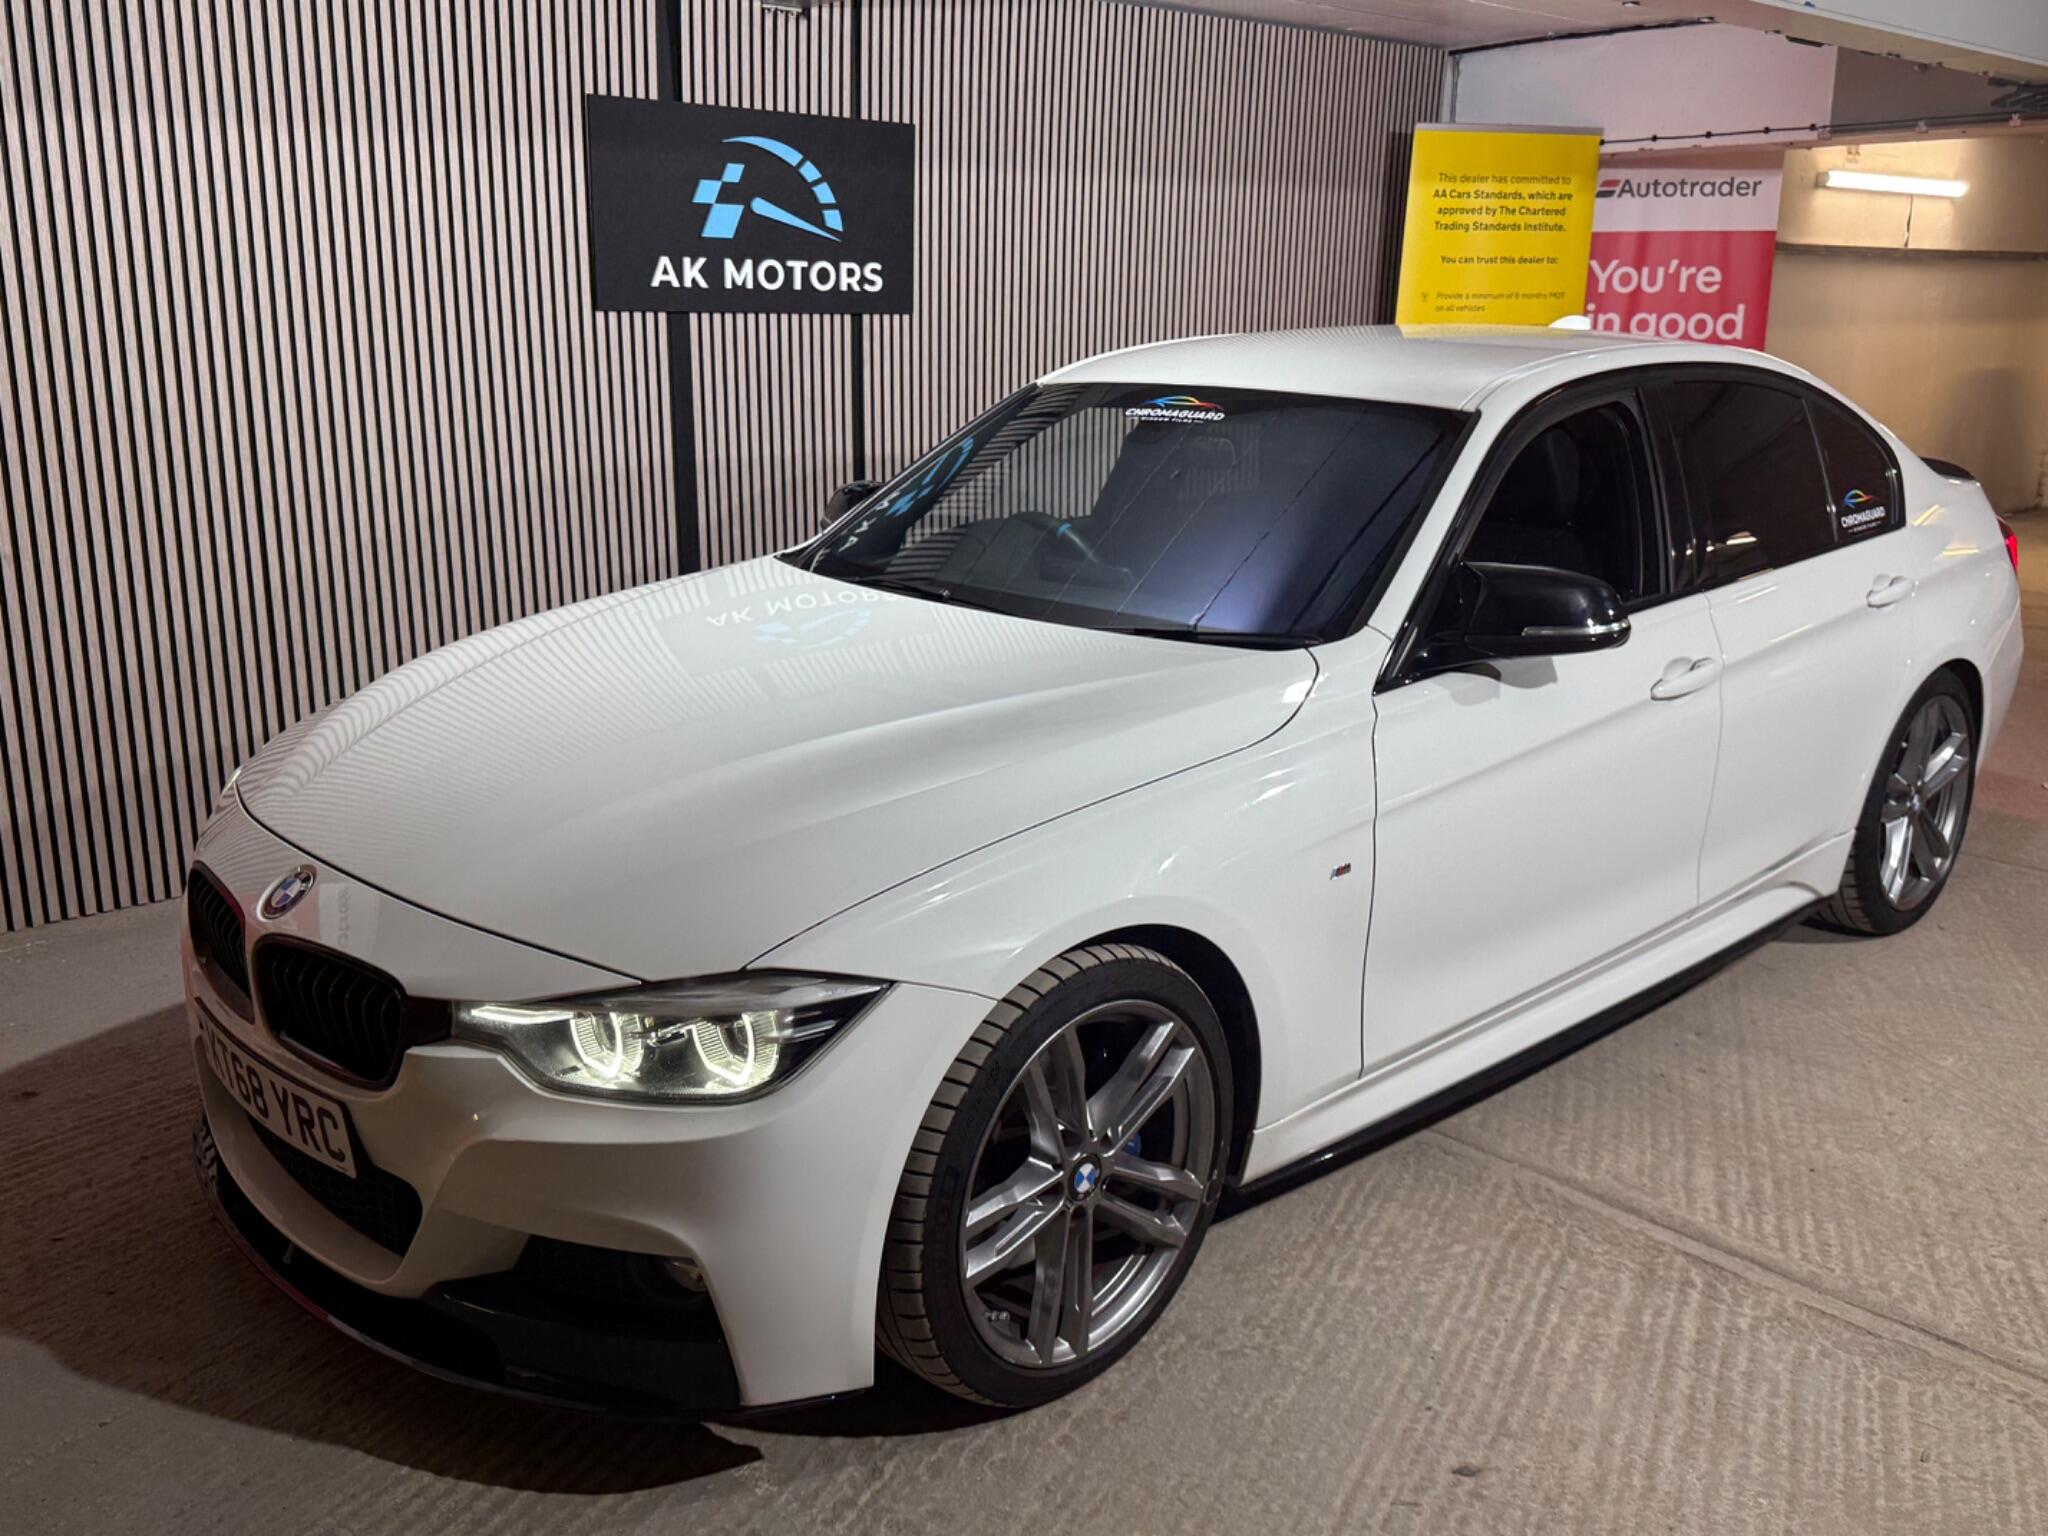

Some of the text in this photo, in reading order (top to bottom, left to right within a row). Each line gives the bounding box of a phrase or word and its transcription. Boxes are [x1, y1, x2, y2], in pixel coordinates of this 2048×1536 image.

[1439, 172, 1572, 185] This dealer has committed to
[1617, 177, 1762, 198] Autotrader
[1433, 189, 1573, 201] AA Cars Standards, which are
[1437, 205, 1566, 217] approved by The Chartered
[1434, 221, 1566, 233] Trading Standards Institute.
[1440, 256, 1558, 265] You can trust this dealer to:
[650, 255, 884, 292] AK MOTORS
[1589, 259, 1722, 294] You're
[1436, 291, 1464, 300] Provide
[1471, 292, 1505, 300] minimum
[1506, 291, 1514, 300] of
[1520, 291, 1548, 300] months
[1548, 291, 1566, 299] MOT
[1446, 304, 1455, 312] all
[1456, 304, 1486, 312] vehicles
[1586, 303, 1745, 340] in good
[270, 1079, 346, 1163] YRC
